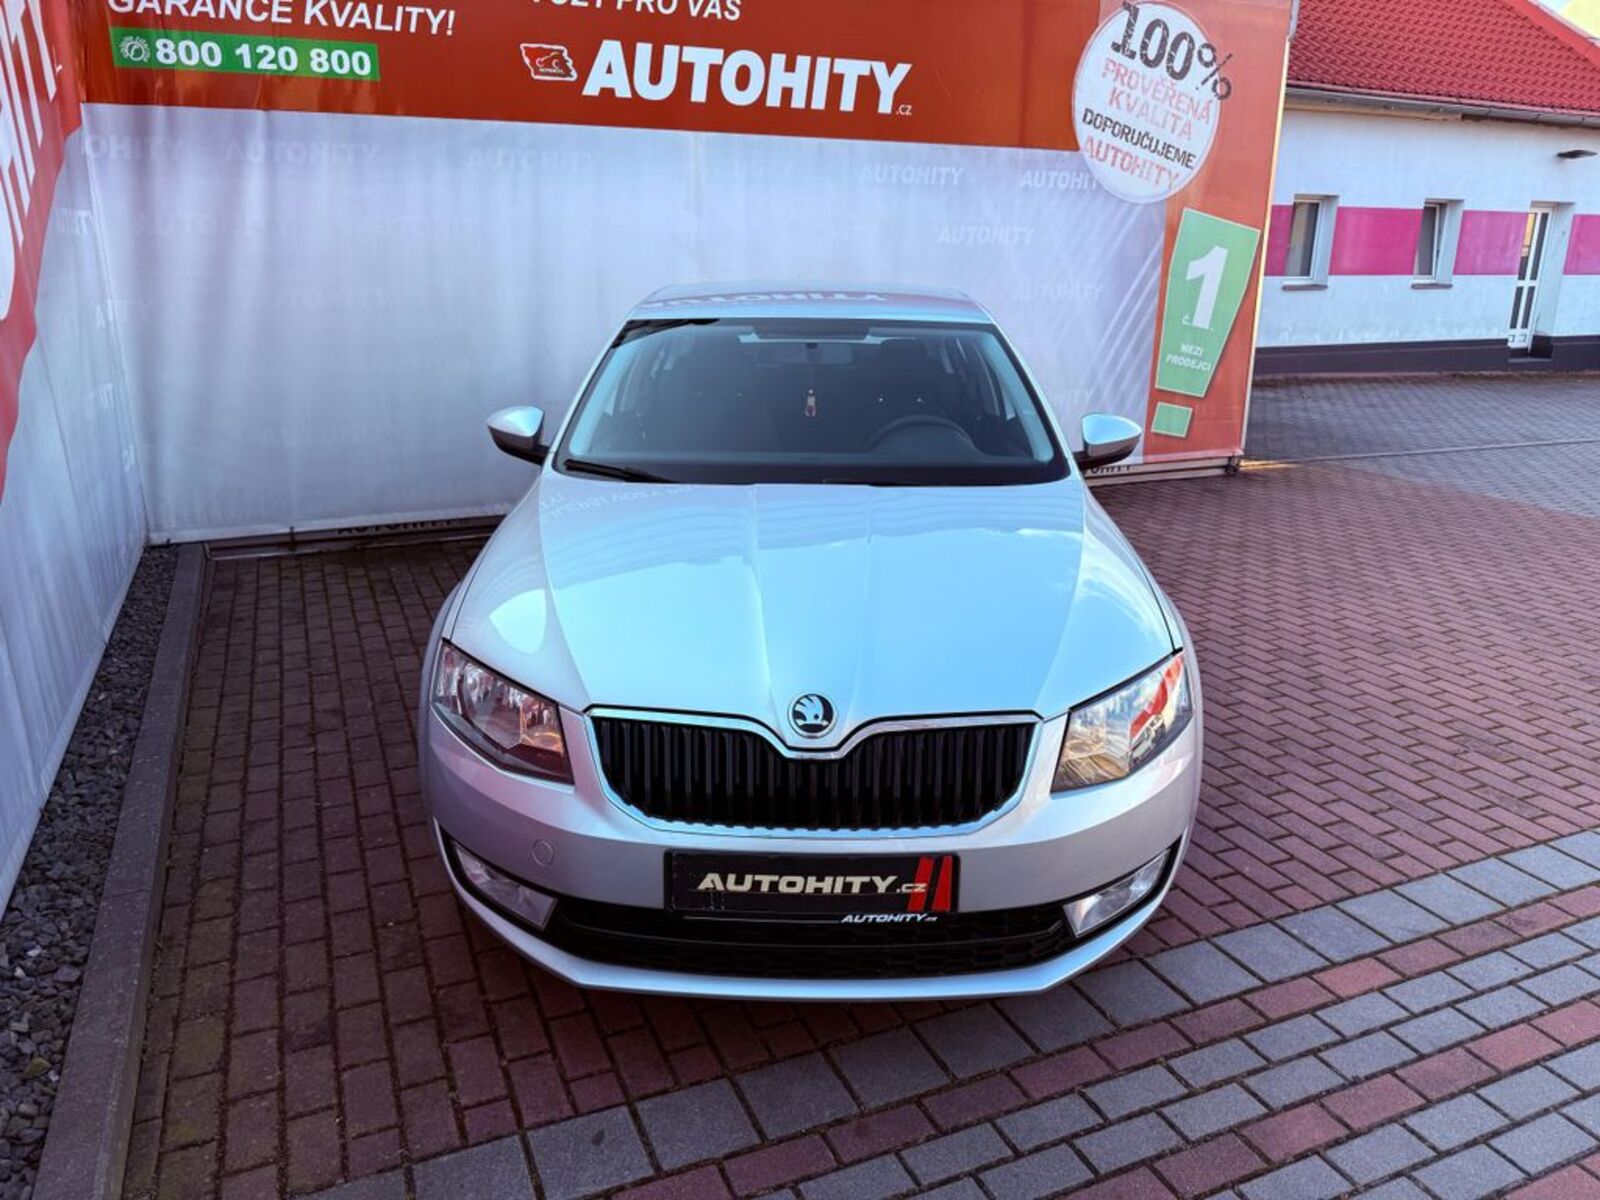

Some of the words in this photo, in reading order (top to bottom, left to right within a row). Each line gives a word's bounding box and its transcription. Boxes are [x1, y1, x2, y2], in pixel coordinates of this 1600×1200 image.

[304, 0, 456, 36] KVALITY!
[155, 38, 222, 67] 800
[235, 44, 298, 71] 120
[309, 48, 371, 76] 800
[1111, 1, 1233, 100] 100%
[1082, 107, 1197, 170] DOPORUČUJEME
[1108, 86, 1193, 141] KVALITA
[859, 164, 965, 187] AUTOHITY
[1085, 134, 1180, 192] AUTOHITY
[936, 224, 1035, 246] AUTOHITY
[1186, 245, 1228, 330] 1
